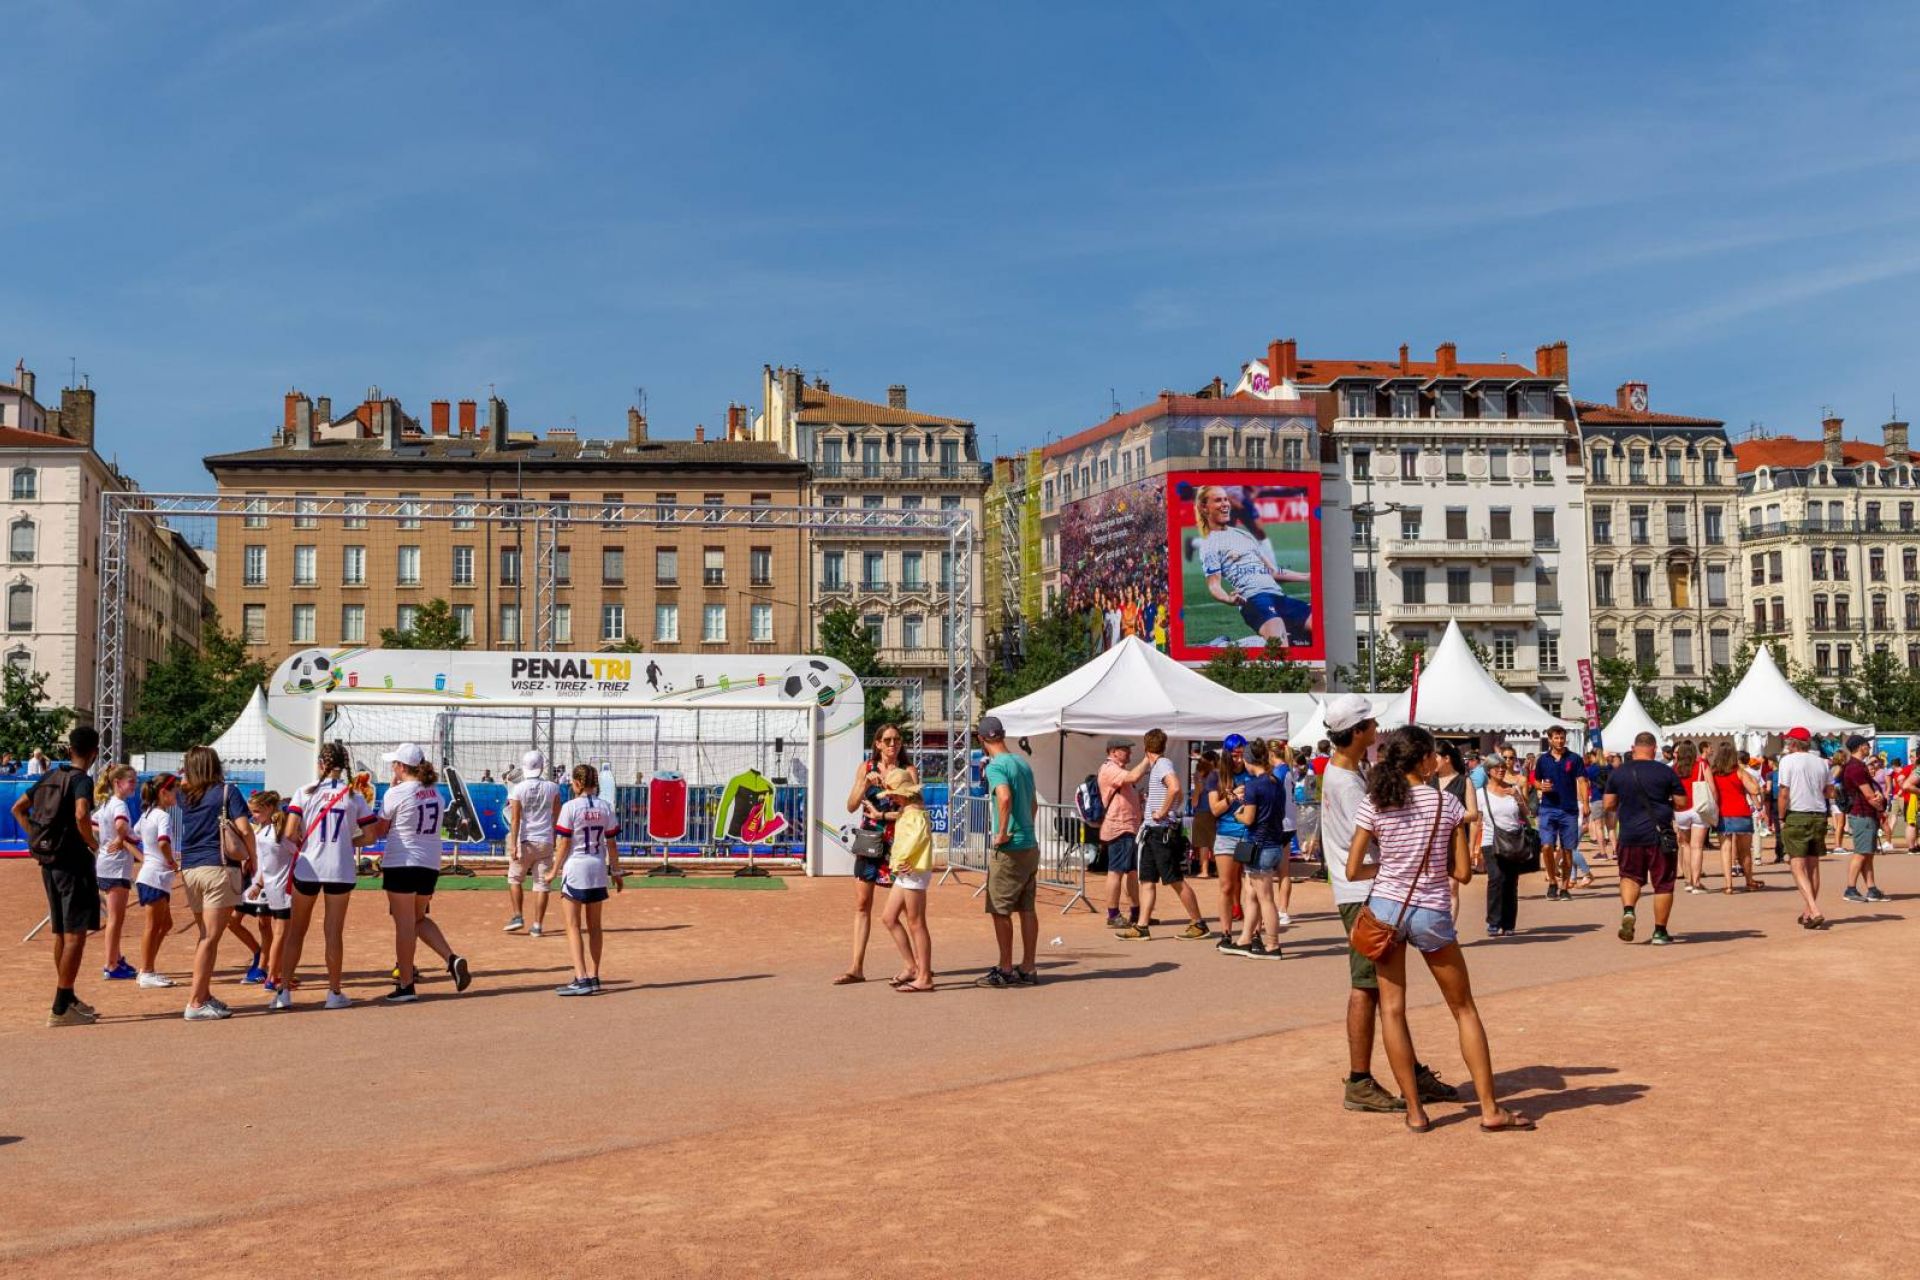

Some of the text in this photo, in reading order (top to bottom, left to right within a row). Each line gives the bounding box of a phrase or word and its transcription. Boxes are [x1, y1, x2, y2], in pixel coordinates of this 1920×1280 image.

[511, 658, 631, 680] PENALTRI
[511, 681, 544, 690] VISEZ
[554, 681, 587, 691] TIREZ
[597, 682, 629, 691] TRIEZ
[319, 808, 345, 842] 17
[415, 802, 439, 835] 13
[583, 825, 604, 854] 17
